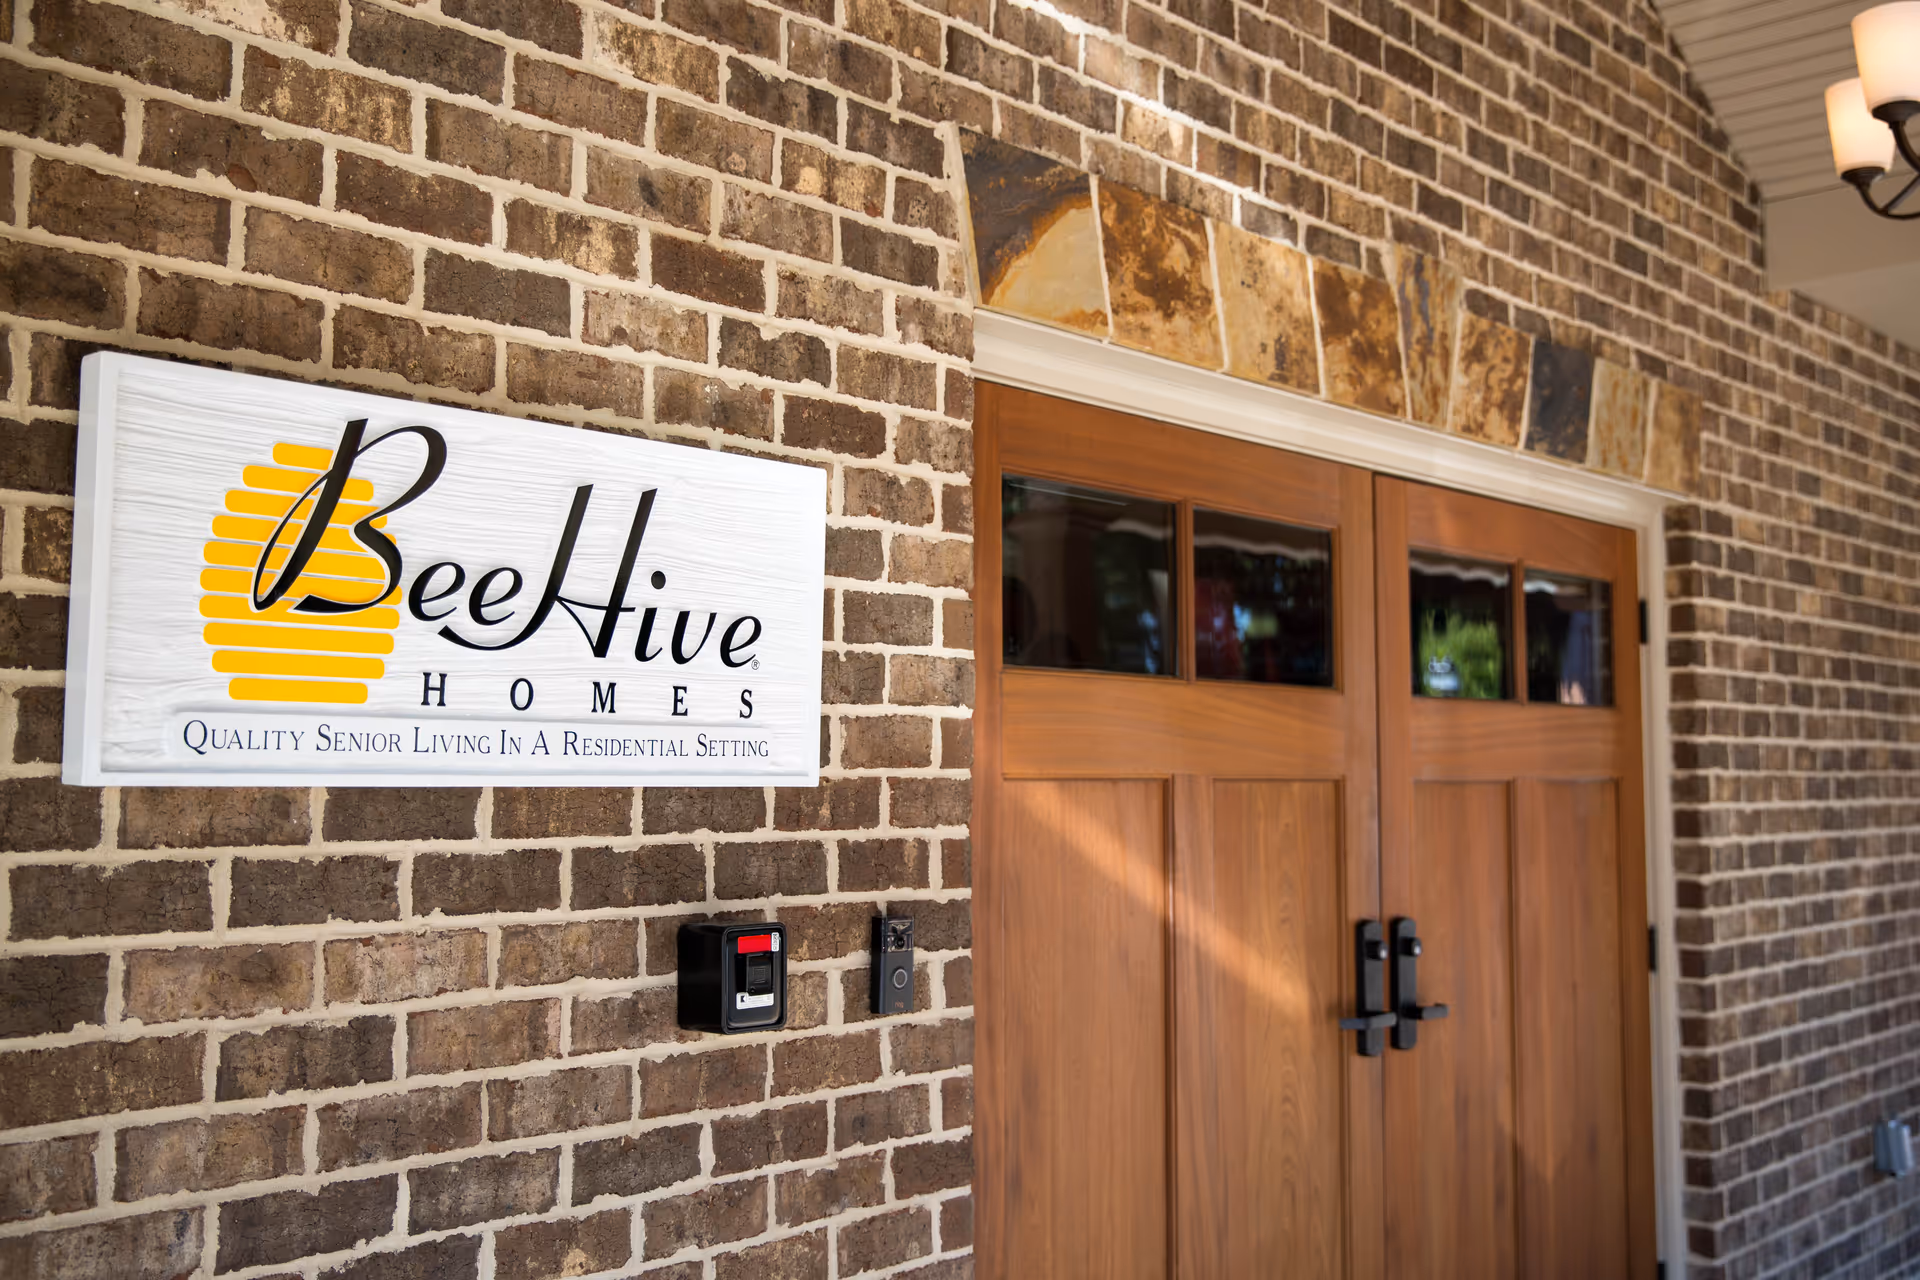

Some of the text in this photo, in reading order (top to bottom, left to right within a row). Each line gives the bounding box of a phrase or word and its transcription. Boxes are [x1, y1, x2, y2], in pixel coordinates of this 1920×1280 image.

[252, 417, 763, 668] BeeHive
[420, 671, 753, 719] HOMES
[183, 719, 305, 756] QUALITY
[315, 723, 402, 753] SENIOR
[413, 726, 491, 755] LIVING
[531, 730, 550, 756] A
[563, 730, 688, 757] RESIDENTIAL
[696, 733, 769, 758] SETTING
